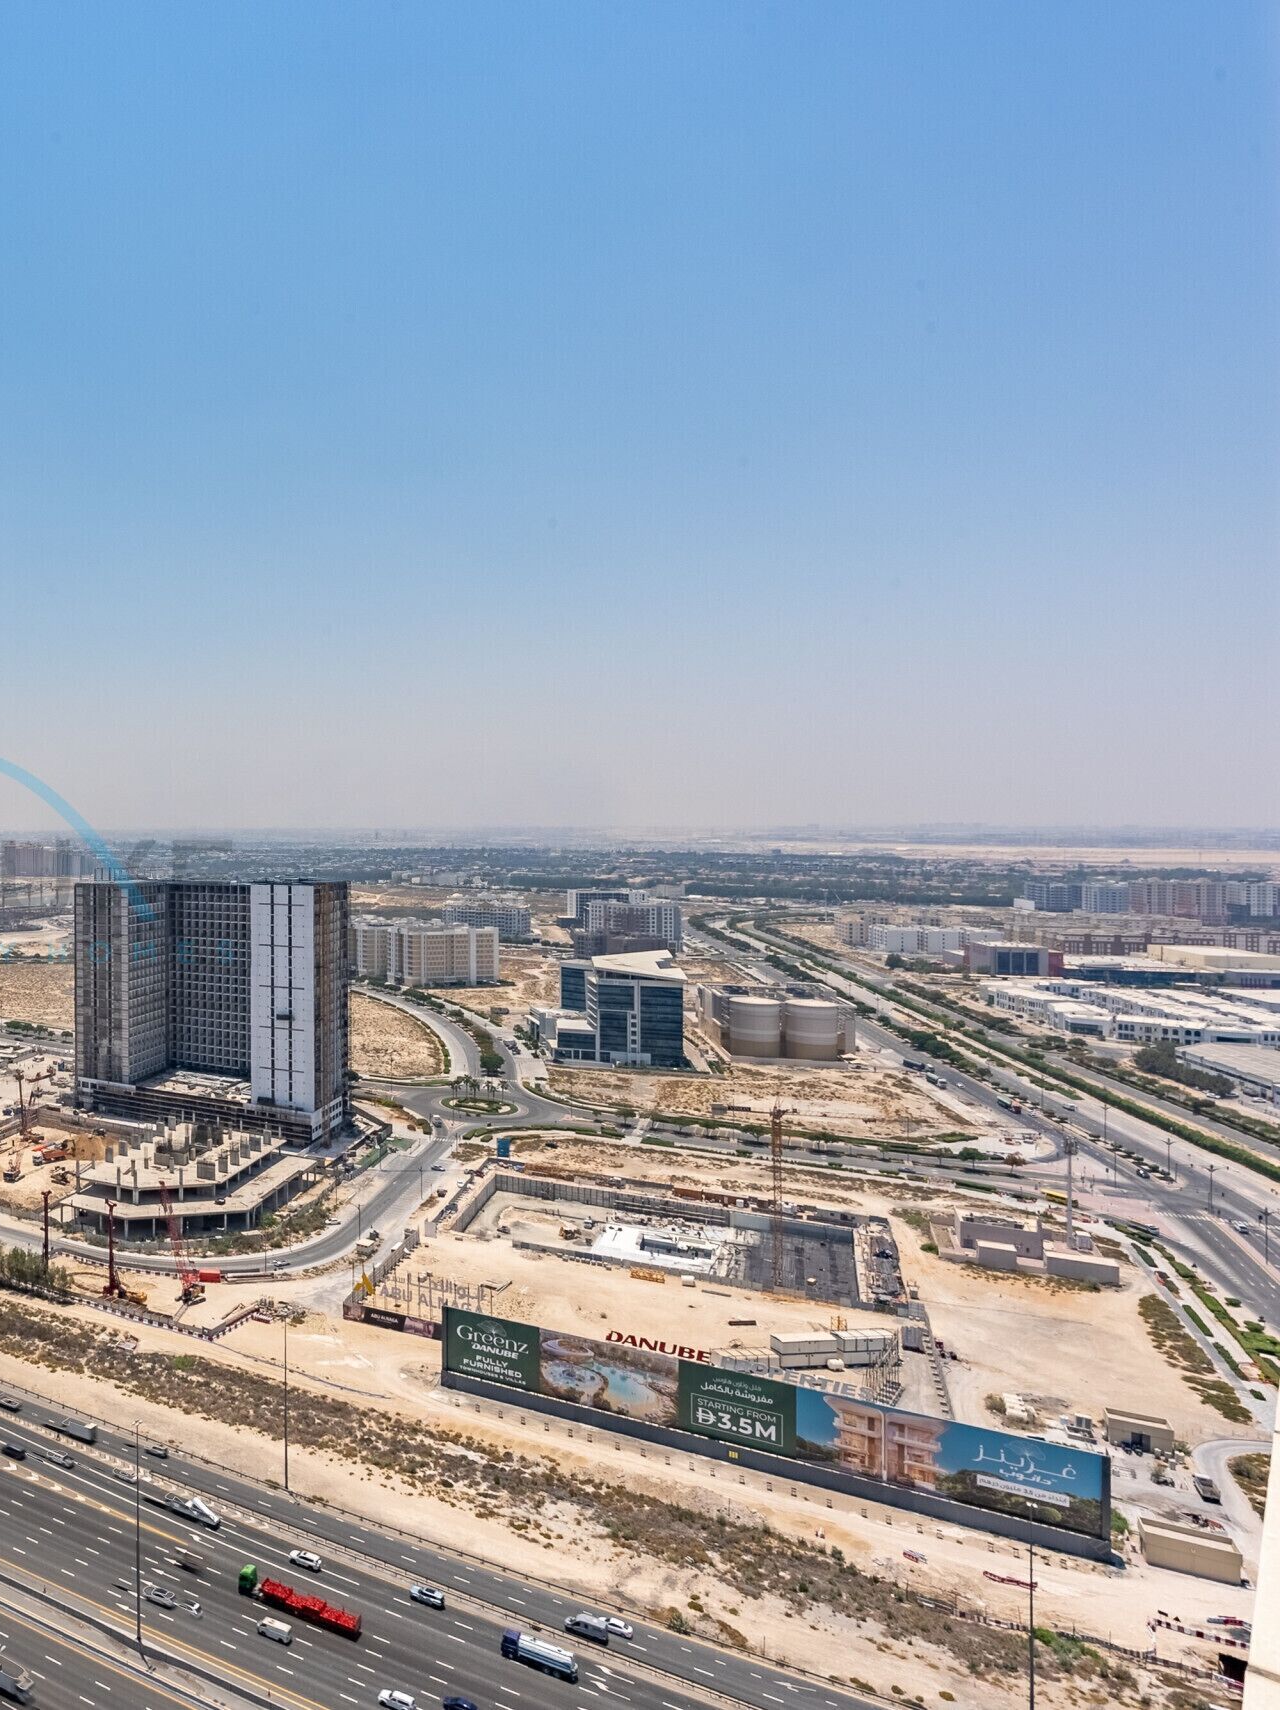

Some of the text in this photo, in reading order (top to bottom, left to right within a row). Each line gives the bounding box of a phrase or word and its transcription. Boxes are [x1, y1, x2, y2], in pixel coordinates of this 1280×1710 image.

[380, 1283, 413, 1303] ABU
[456, 1324, 529, 1355] Greenz
[606, 1330, 712, 1362] DANUBE
[472, 1343, 519, 1360] DANUBE
[476, 1355, 508, 1368] FULLY
[463, 1358, 522, 1378] FURNISHED
[701, 1382, 773, 1404] مفروشة بالكامل
[698, 1398, 777, 1423] STARTING FROM
